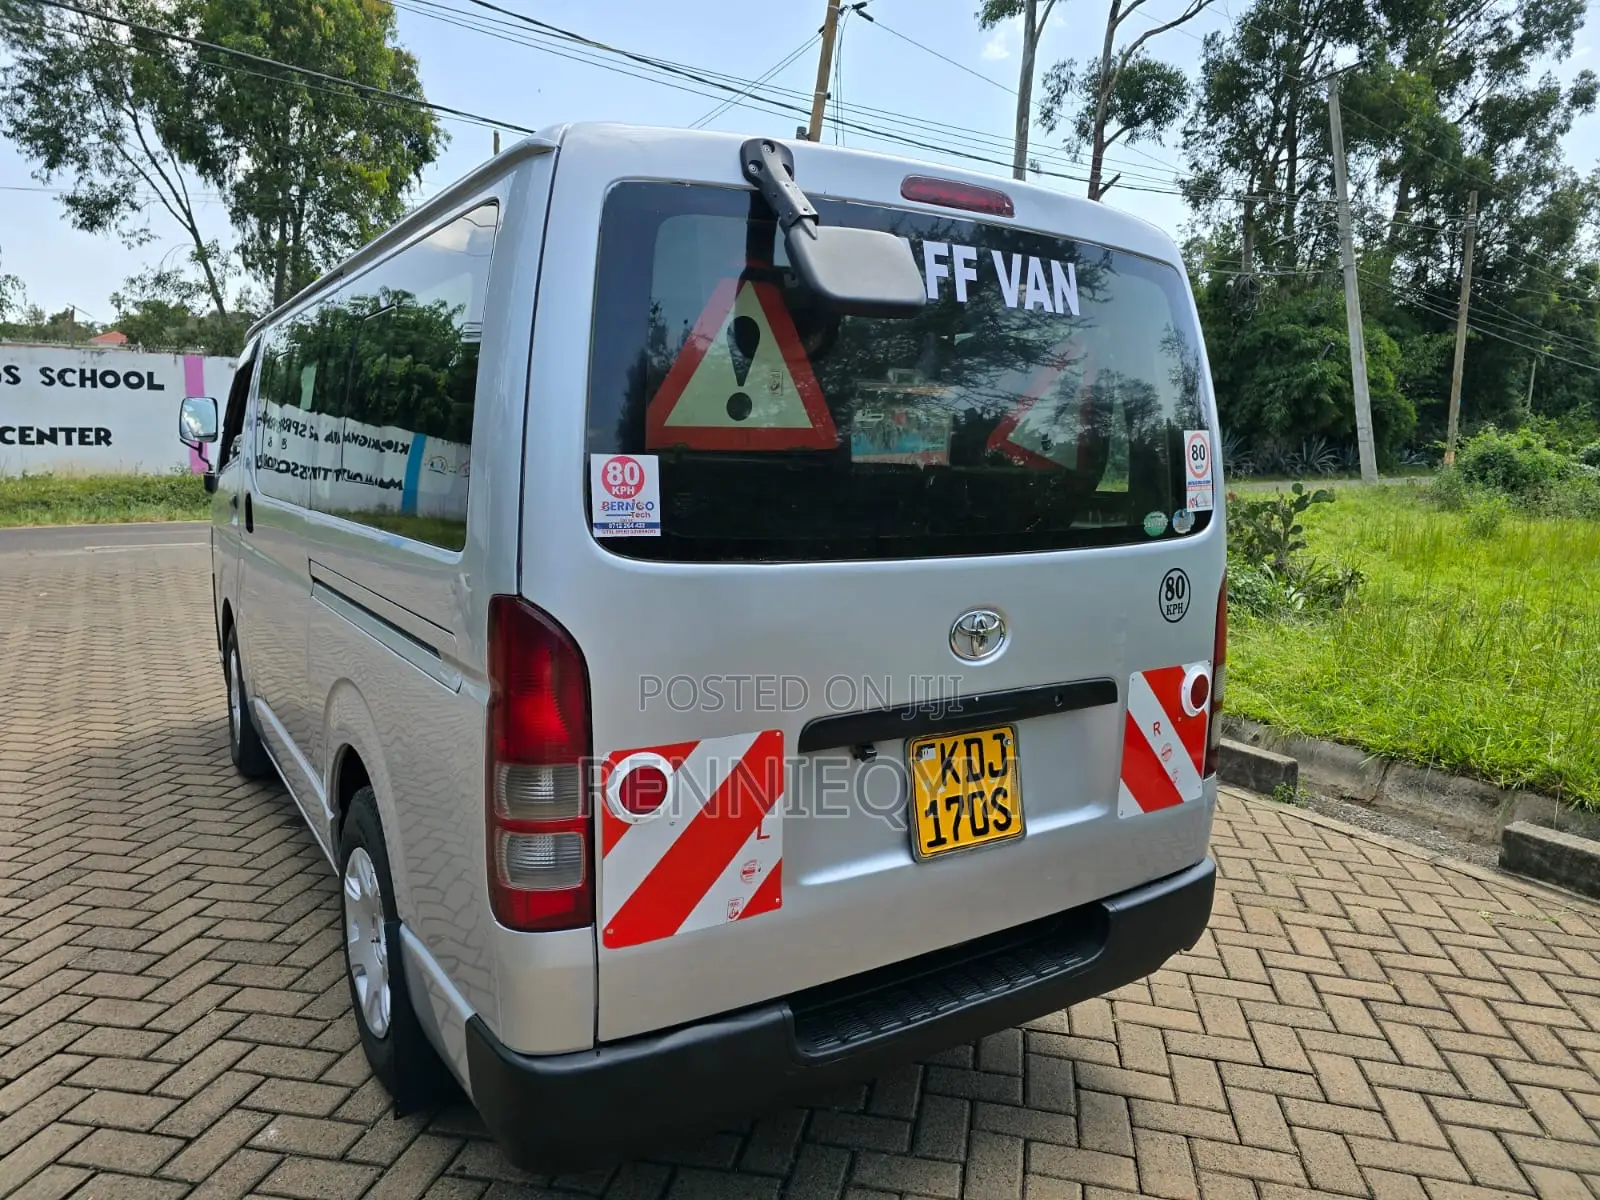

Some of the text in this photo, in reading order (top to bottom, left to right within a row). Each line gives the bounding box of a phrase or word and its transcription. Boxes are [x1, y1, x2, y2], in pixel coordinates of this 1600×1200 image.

[903, 237, 1080, 316] FF VAN
[0, 365, 165, 391] S SCHOOL
[0, 426, 112, 446] CENTER
[1191, 444, 1206, 461] 80
[607, 461, 640, 486] 80
[612, 486, 634, 495] KPH
[1165, 575, 1185, 601] 80
[1166, 602, 1183, 615] KPH
[1153, 721, 1161, 736] R
[939, 733, 1008, 787] KDJ
[757, 818, 770, 840] L
[924, 787, 1012, 848] 170S
